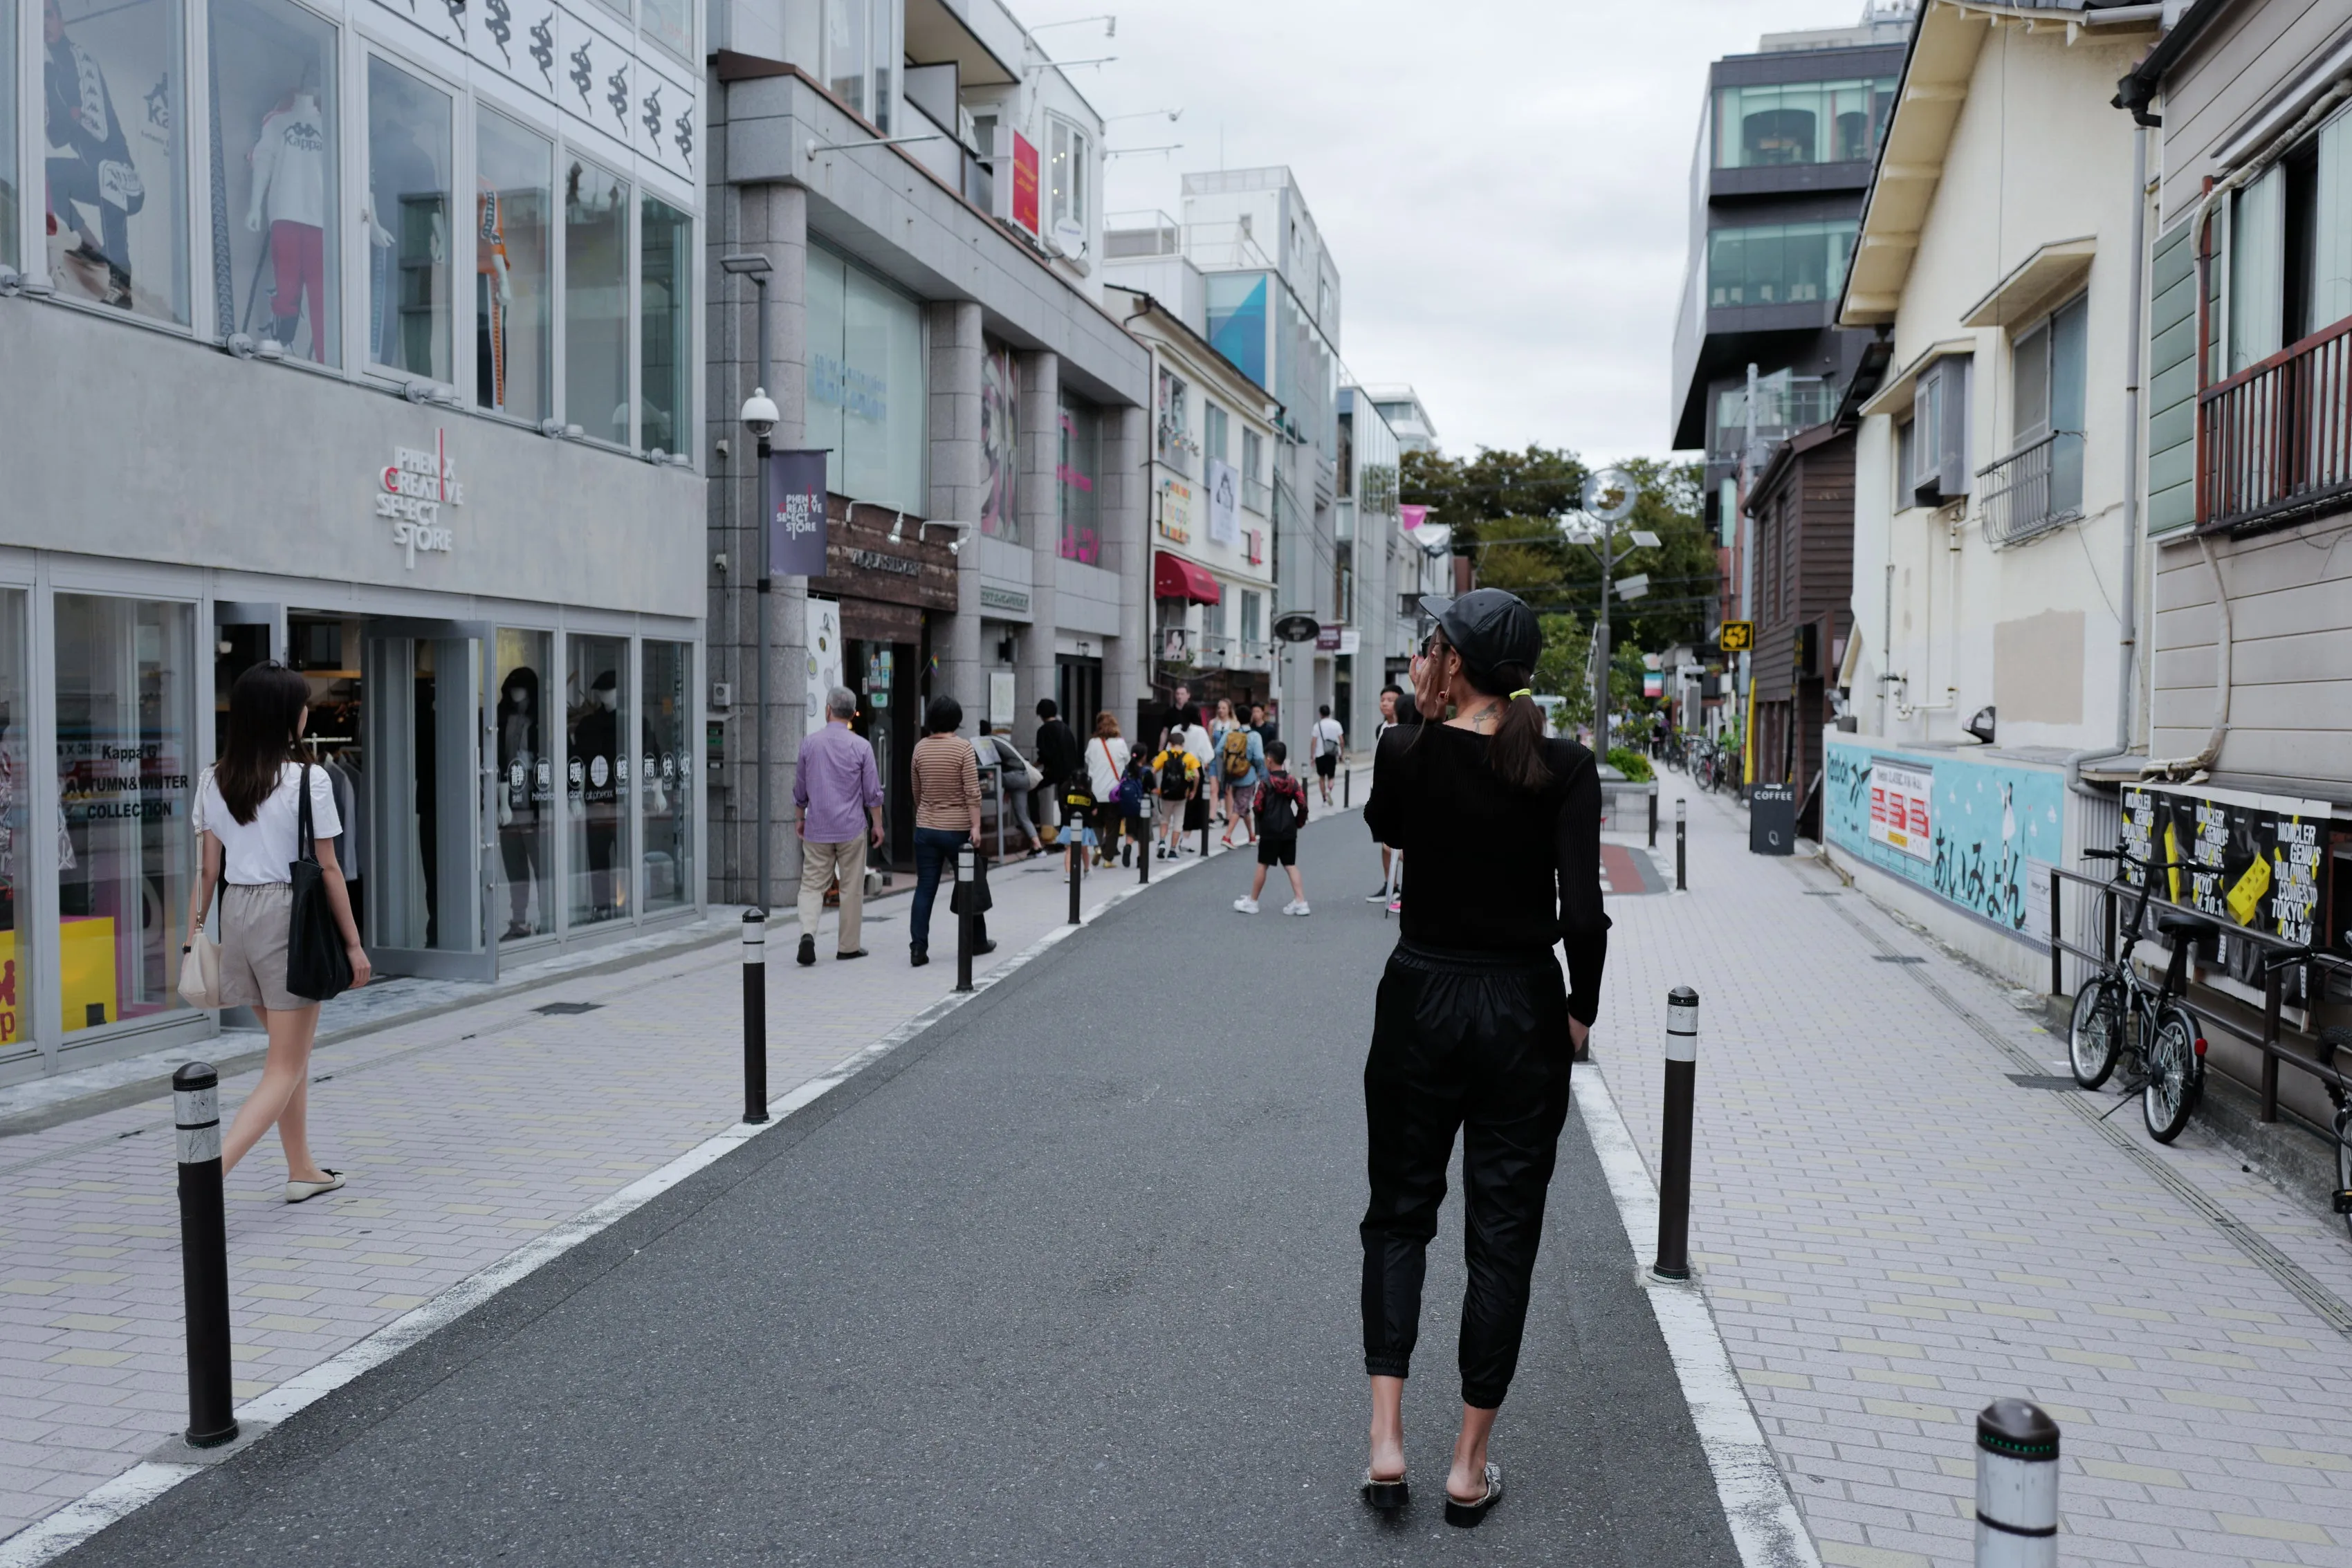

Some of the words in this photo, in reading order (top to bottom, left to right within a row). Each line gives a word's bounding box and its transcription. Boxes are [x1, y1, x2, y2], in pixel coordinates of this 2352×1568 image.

[283, 132, 322, 151] Kappa
[394, 427, 457, 481] PHENIX
[380, 465, 463, 506] CREATIVE
[376, 492, 439, 526] SELECT
[776, 513, 809, 523] SELECT
[778, 502, 823, 513] CREATIVE
[786, 522, 816, 540] STORE
[393, 522, 452, 569] STORE
[103, 746, 143, 762] Kappa
[538, 763, 550, 784] 陽
[569, 762, 582, 782] 暖
[644, 758, 655, 777] 雨
[663, 757, 673, 776] 快
[568, 790, 582, 799] dan
[1754, 791, 1793, 801] COFFEE
[2125, 791, 2151, 811] MONCLER
[87, 802, 172, 819] COLLECTION
[2134, 809, 2154, 827] GENIUS
[2277, 822, 2316, 845] MONCLER
[2290, 843, 2322, 867] GENIUS
[1934, 827, 2026, 930] あいみょん
[2274, 860, 2310, 885] BUILDING
[2278, 880, 2309, 904] COMES
[2308, 887, 2317, 908] TO
[2272, 898, 2304, 923] TOKYO
